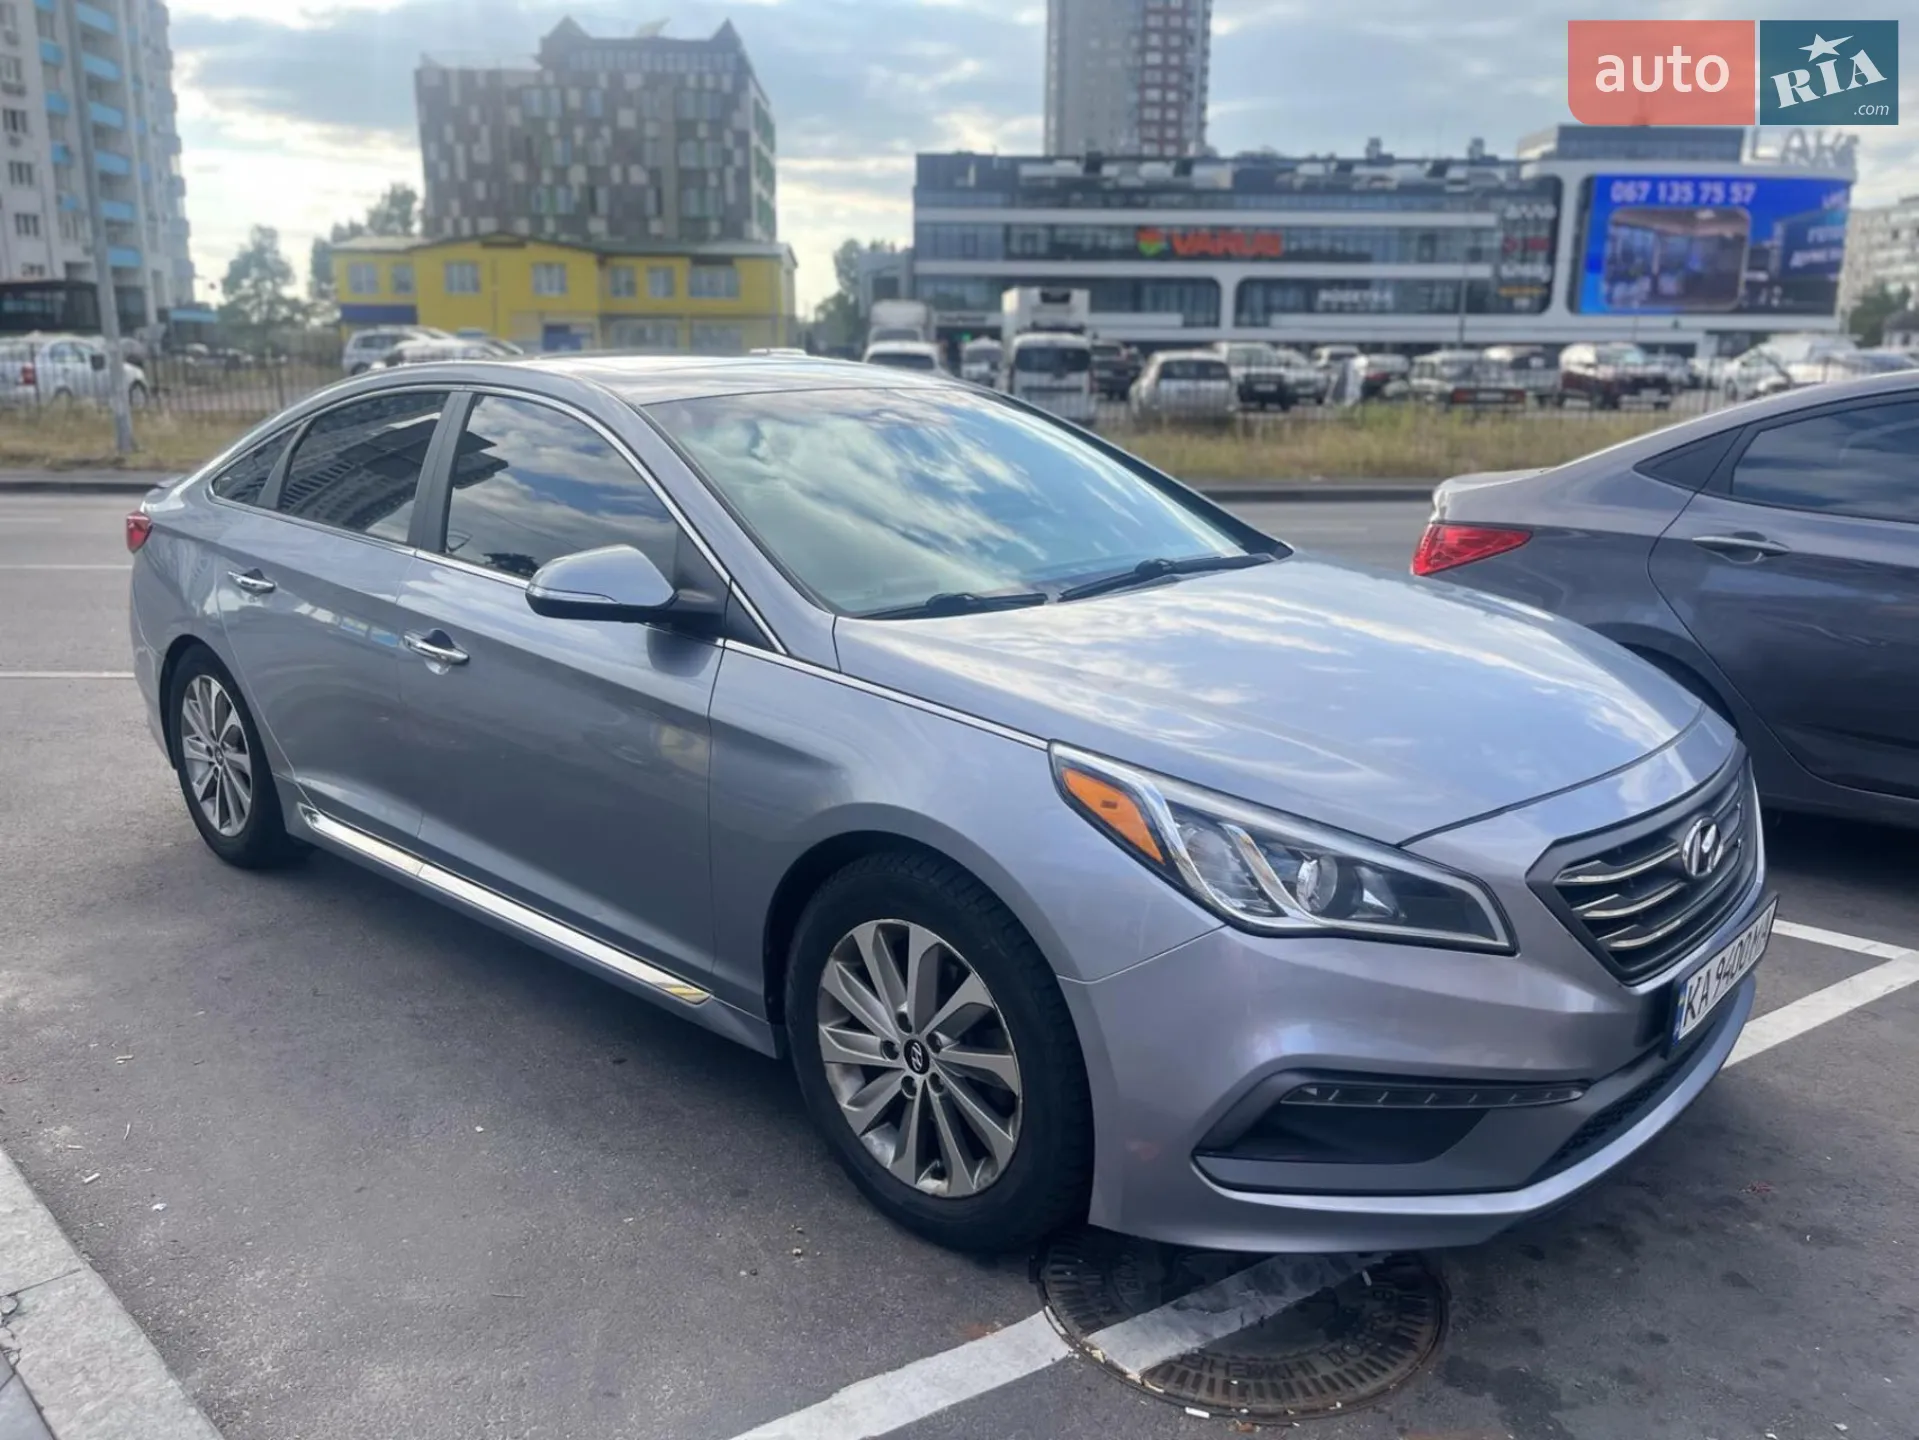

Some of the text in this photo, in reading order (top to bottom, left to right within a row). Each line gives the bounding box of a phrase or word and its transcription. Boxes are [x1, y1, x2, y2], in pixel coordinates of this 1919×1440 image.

[1610, 180, 1757, 205] 067 135 75 57
